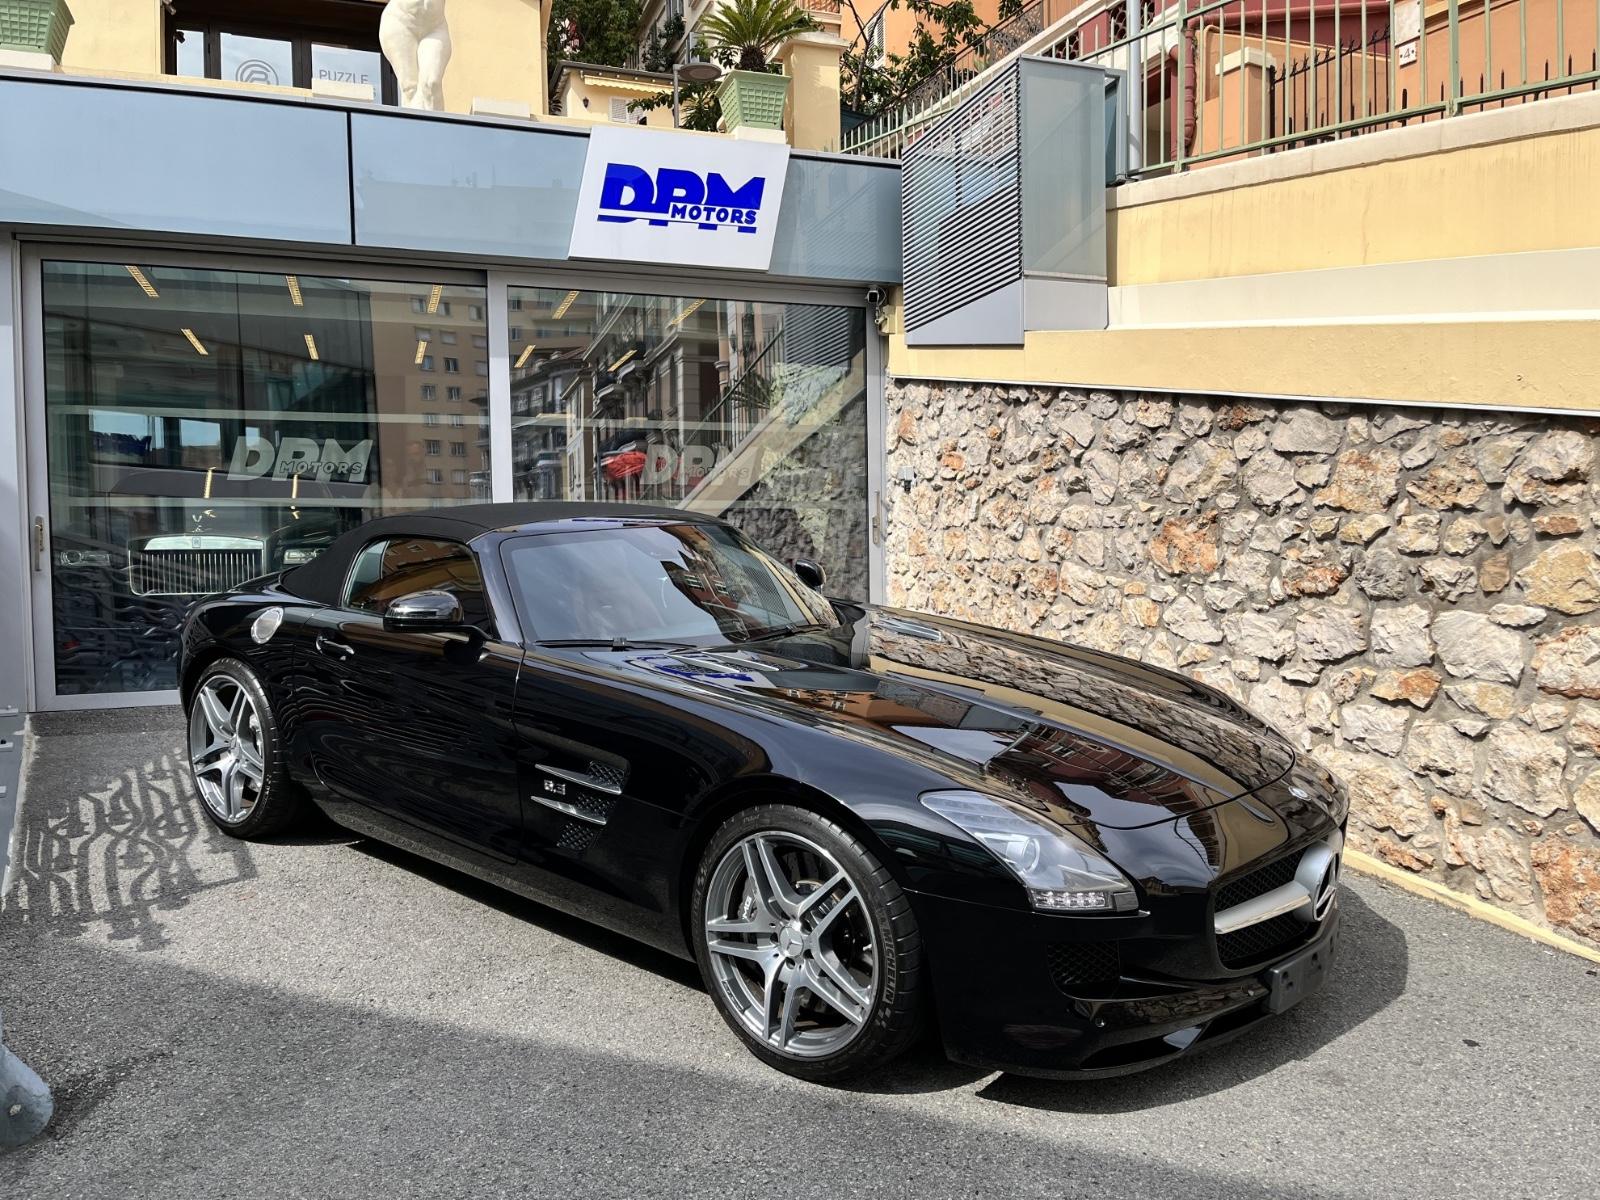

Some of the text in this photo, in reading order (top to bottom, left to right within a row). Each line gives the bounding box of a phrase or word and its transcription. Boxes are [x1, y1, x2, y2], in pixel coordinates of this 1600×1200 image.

[1403, 48, 1411, 58] 4
[320, 69, 368, 85] PUZZLE
[597, 162, 765, 233] DPM
[670, 203, 757, 225] MOTORS
[227, 435, 373, 483] DPM
[279, 459, 362, 475] MOTORS
[742, 895, 752, 919] MG
[882, 926, 896, 1004] MICHELIN
